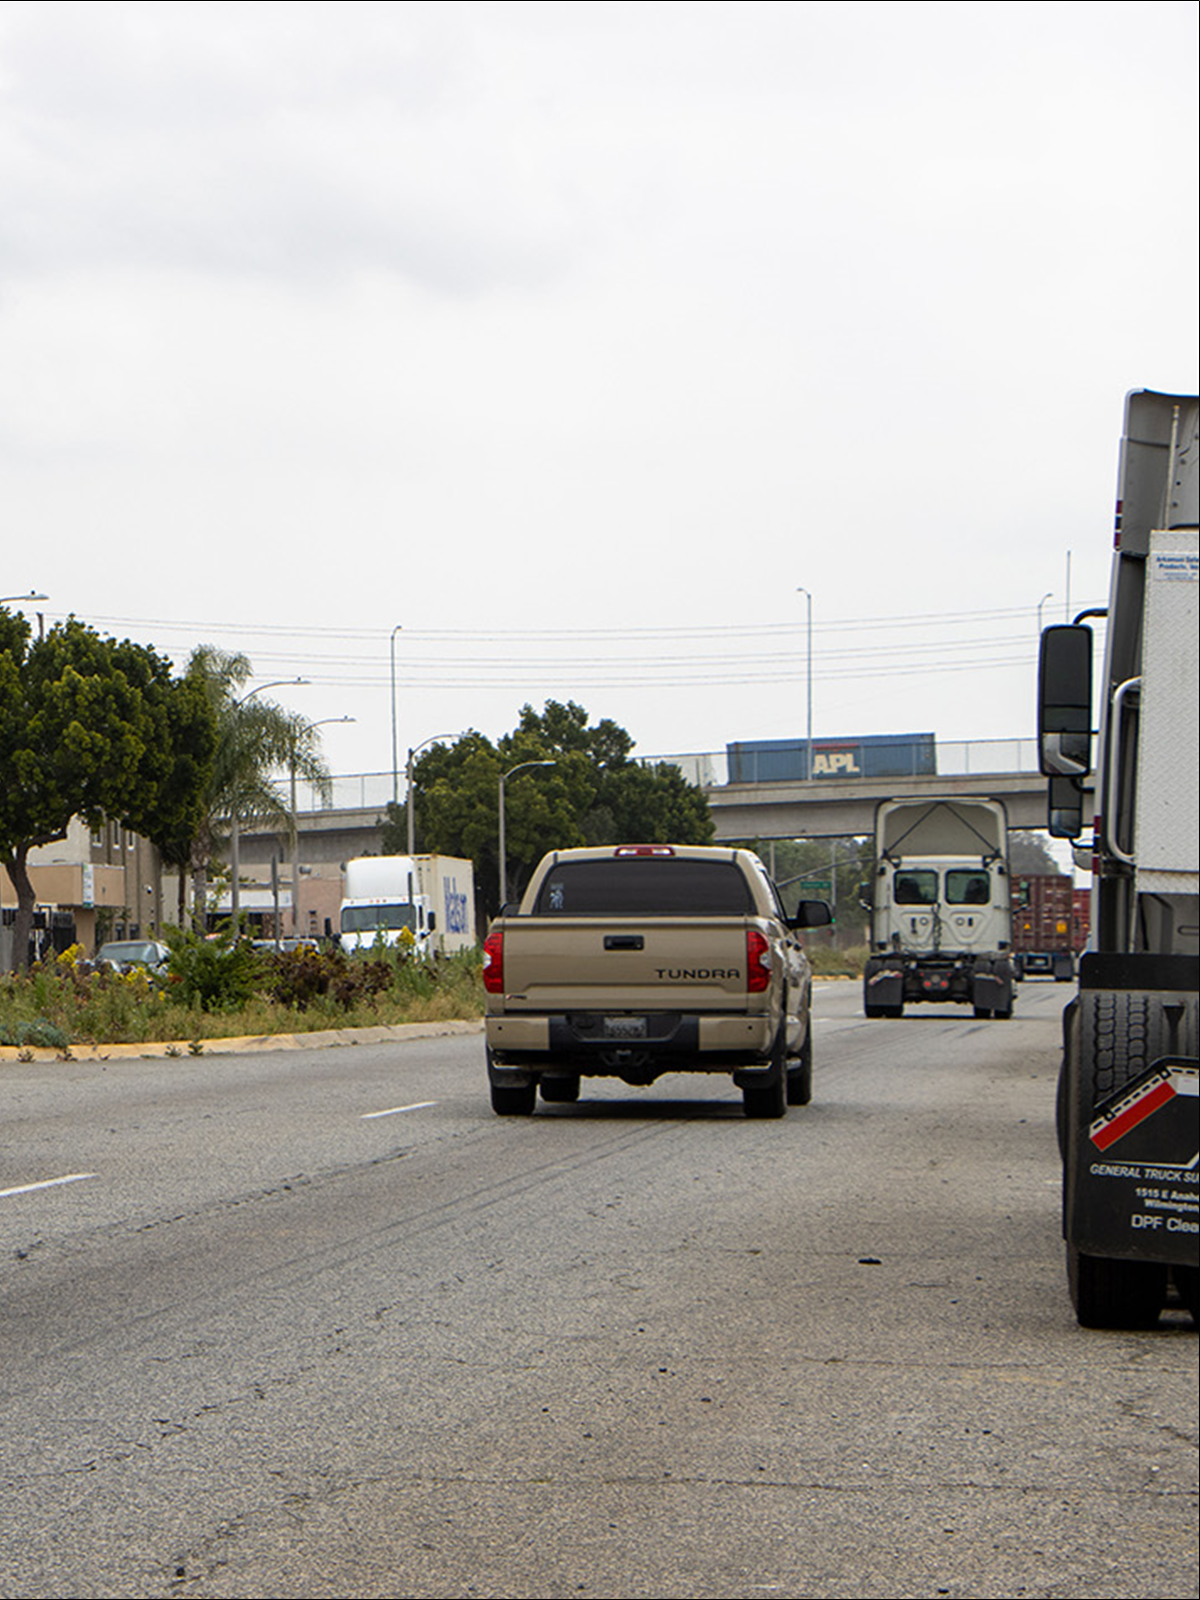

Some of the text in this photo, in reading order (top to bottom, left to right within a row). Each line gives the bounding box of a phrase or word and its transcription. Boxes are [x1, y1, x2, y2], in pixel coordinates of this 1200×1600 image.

[812, 753, 860, 773] APL
[655, 969, 740, 979] TUNDRA
[1090, 1163, 1141, 1179] GENERAL
[1144, 1168, 1182, 1182] TRUCK
[1135, 1187, 1159, 1198] 1515
[1161, 1189, 1169, 1199] E
[1131, 1214, 1163, 1230] DPF
